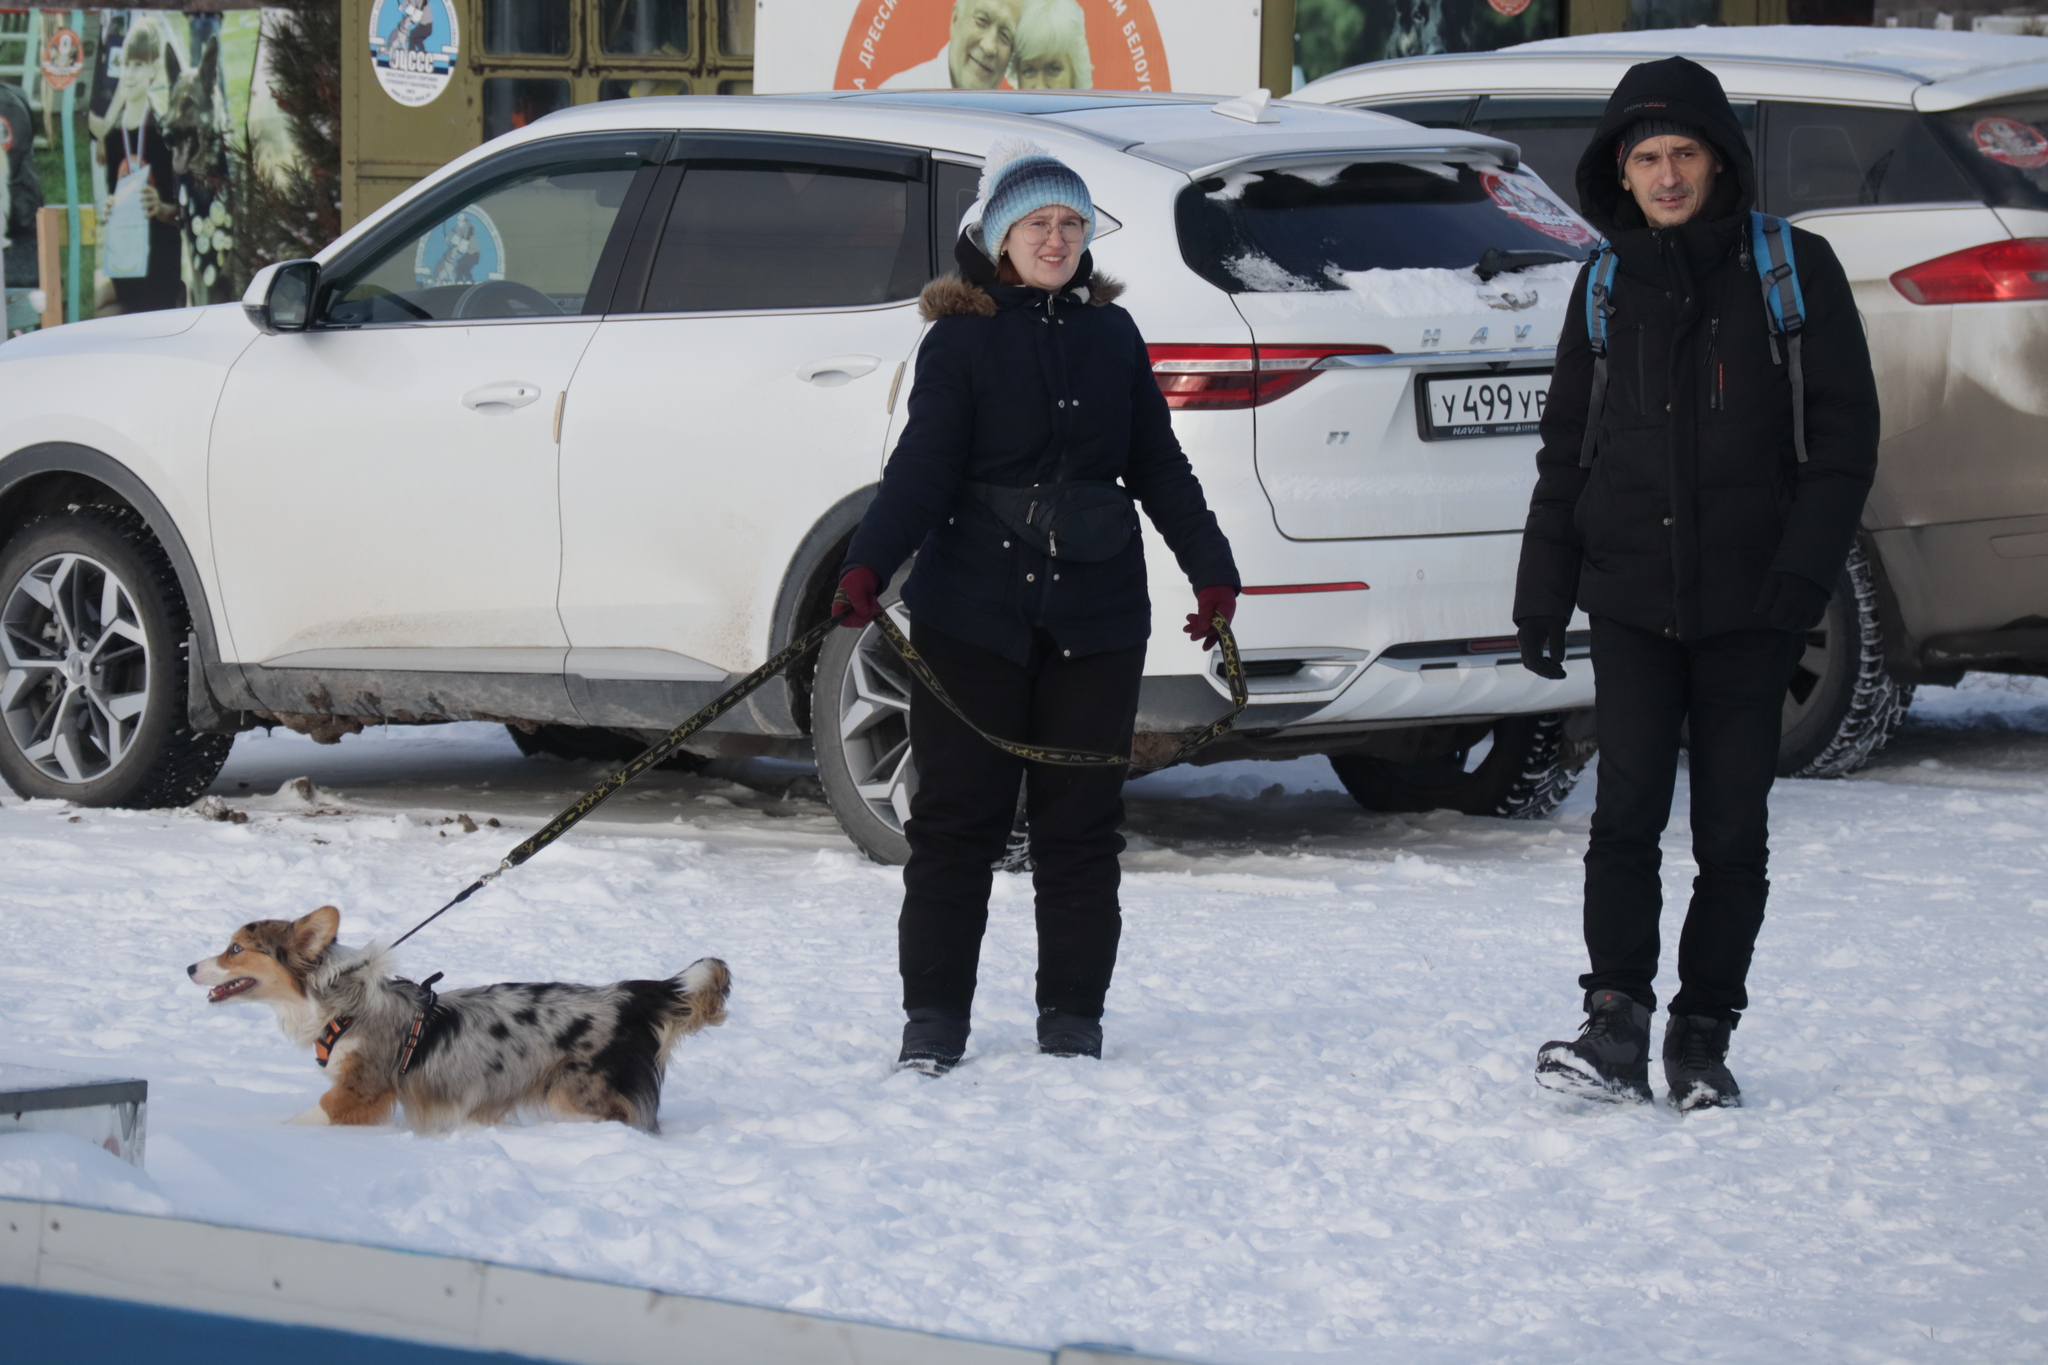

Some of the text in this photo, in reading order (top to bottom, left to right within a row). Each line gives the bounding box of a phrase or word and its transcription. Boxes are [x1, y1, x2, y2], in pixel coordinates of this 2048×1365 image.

[1421, 324, 1560, 347] HAV
[1442, 383, 1547, 423] У499УР
[1325, 431, 1350, 445] F7
[1452, 426, 1486, 436] HAVAL
